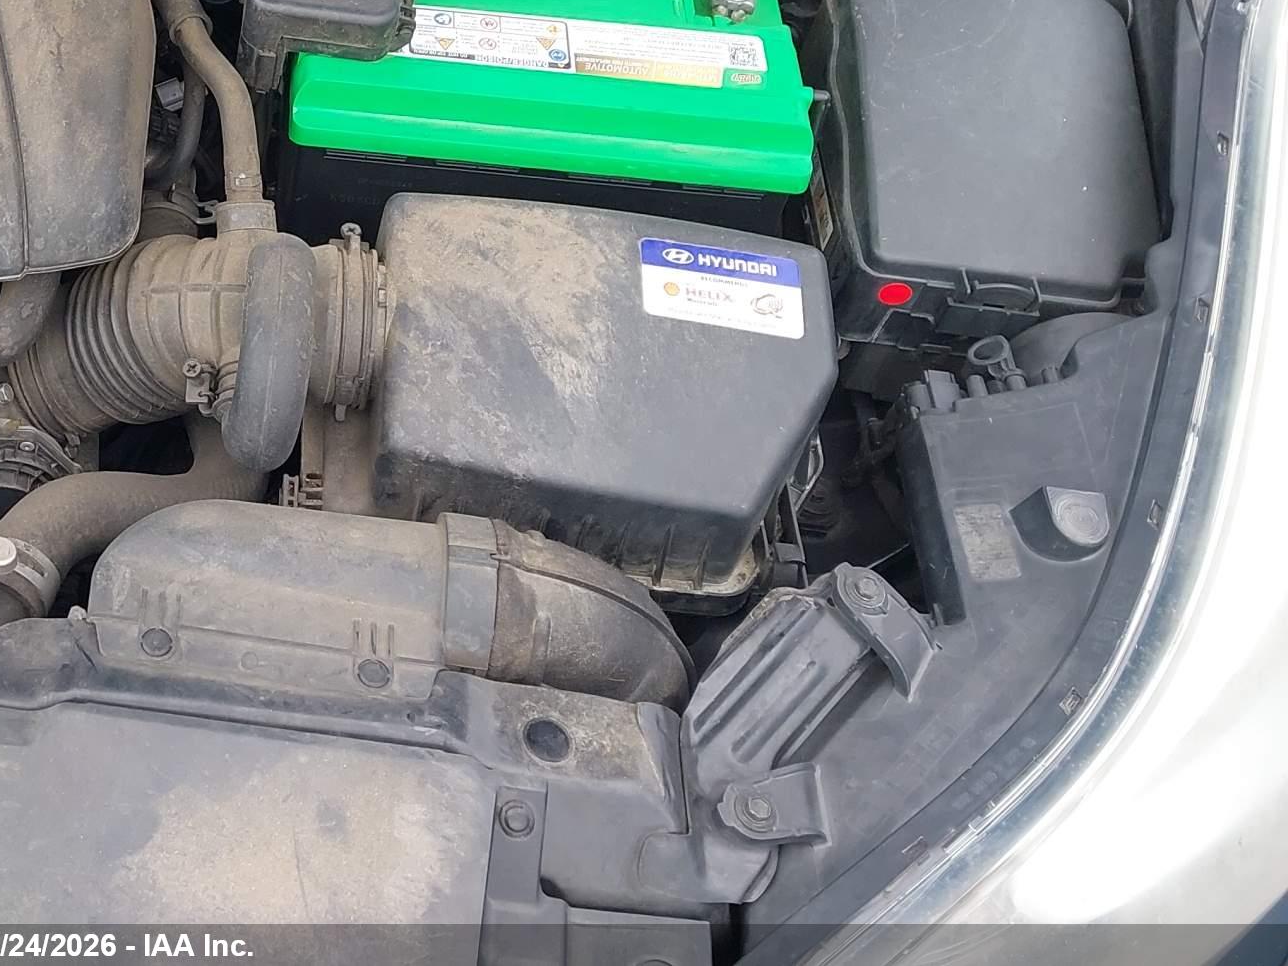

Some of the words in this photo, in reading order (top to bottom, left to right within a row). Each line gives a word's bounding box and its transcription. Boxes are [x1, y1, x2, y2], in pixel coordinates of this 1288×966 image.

[585, 62, 649, 76] AUTOMOTIVE
[697, 253, 778, 277] HYUNDAI
[685, 288, 734, 304] HELIX
